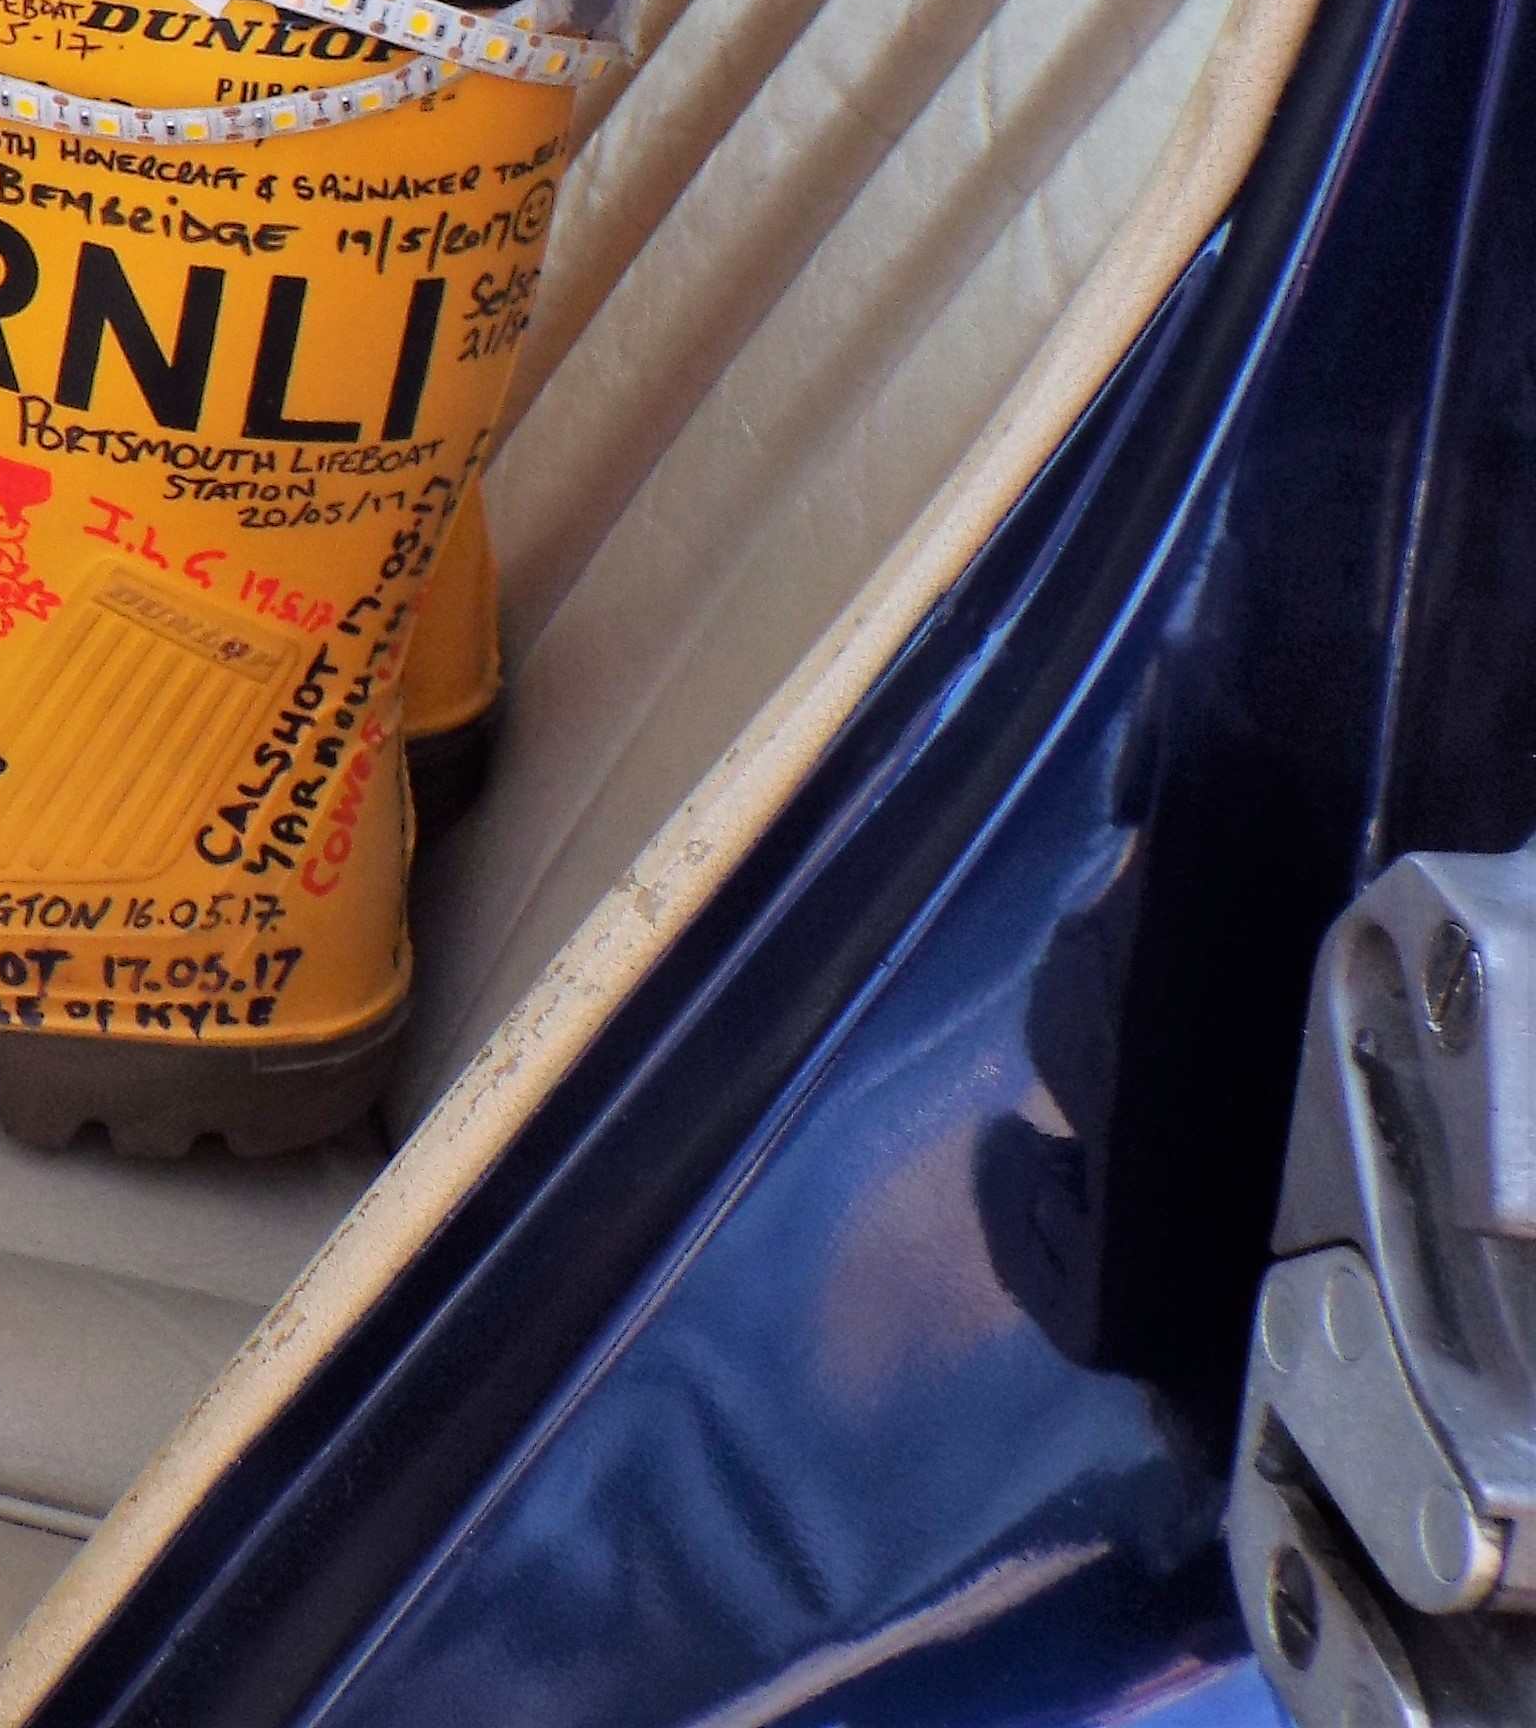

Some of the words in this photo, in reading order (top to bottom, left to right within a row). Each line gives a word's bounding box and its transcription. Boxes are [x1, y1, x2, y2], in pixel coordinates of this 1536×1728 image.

[60, 138, 247, 192] HOVERCRAFT
[17, 394, 276, 475] PORTSMOUTH
[290, 438, 444, 475] LIFEBOAT
[162, 474, 316, 503] STATION
[236, 489, 406, 529] 20/05/17
[194, 643, 340, 866] CALSHOT
[101, 947, 304, 994] 17.05.17
[64, 999, 115, 1033] OF
[134, 997, 278, 1039] KYLE
